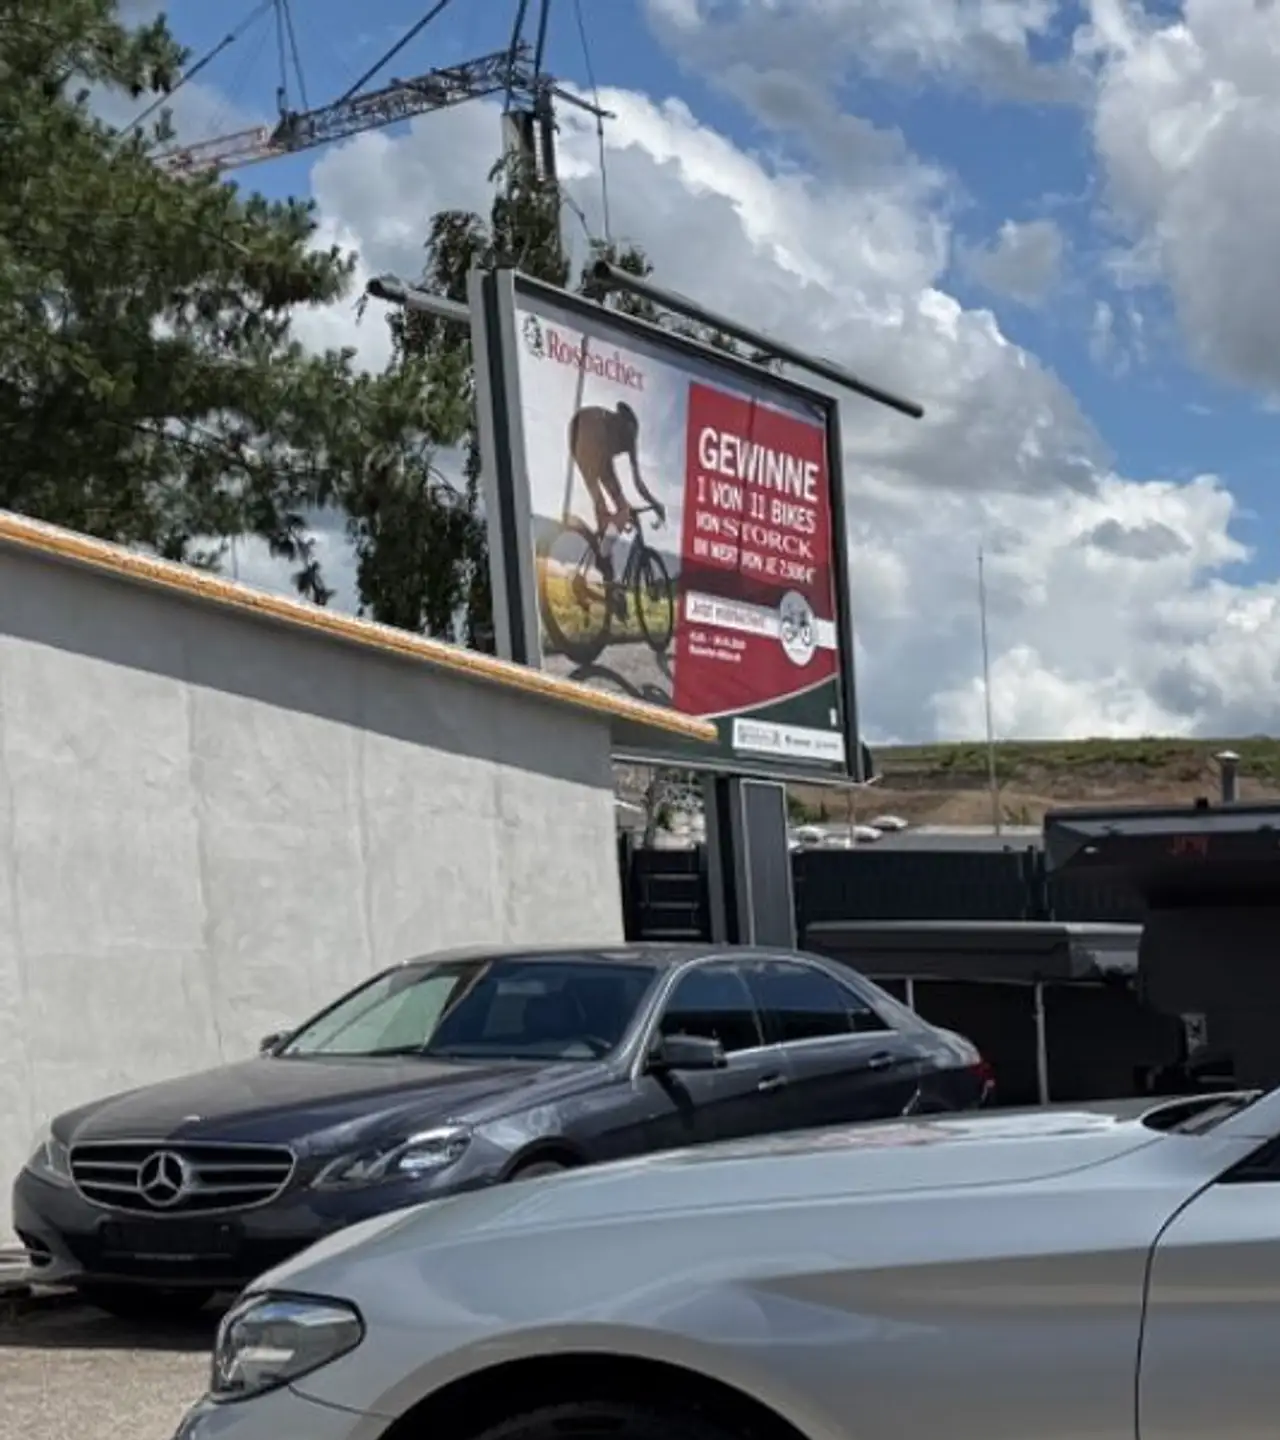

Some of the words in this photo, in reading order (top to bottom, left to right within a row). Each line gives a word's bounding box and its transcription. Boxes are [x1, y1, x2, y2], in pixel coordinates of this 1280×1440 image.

[546, 328, 645, 391] Rosbacher
[698, 427, 820, 502] GEWINNE
[695, 510, 719, 533] VON
[721, 516, 815, 560] STORCK
[697, 476, 706, 504] 1
[711, 479, 743, 512] VON
[749, 492, 765, 519] 11
[771, 500, 817, 534] BIKES
